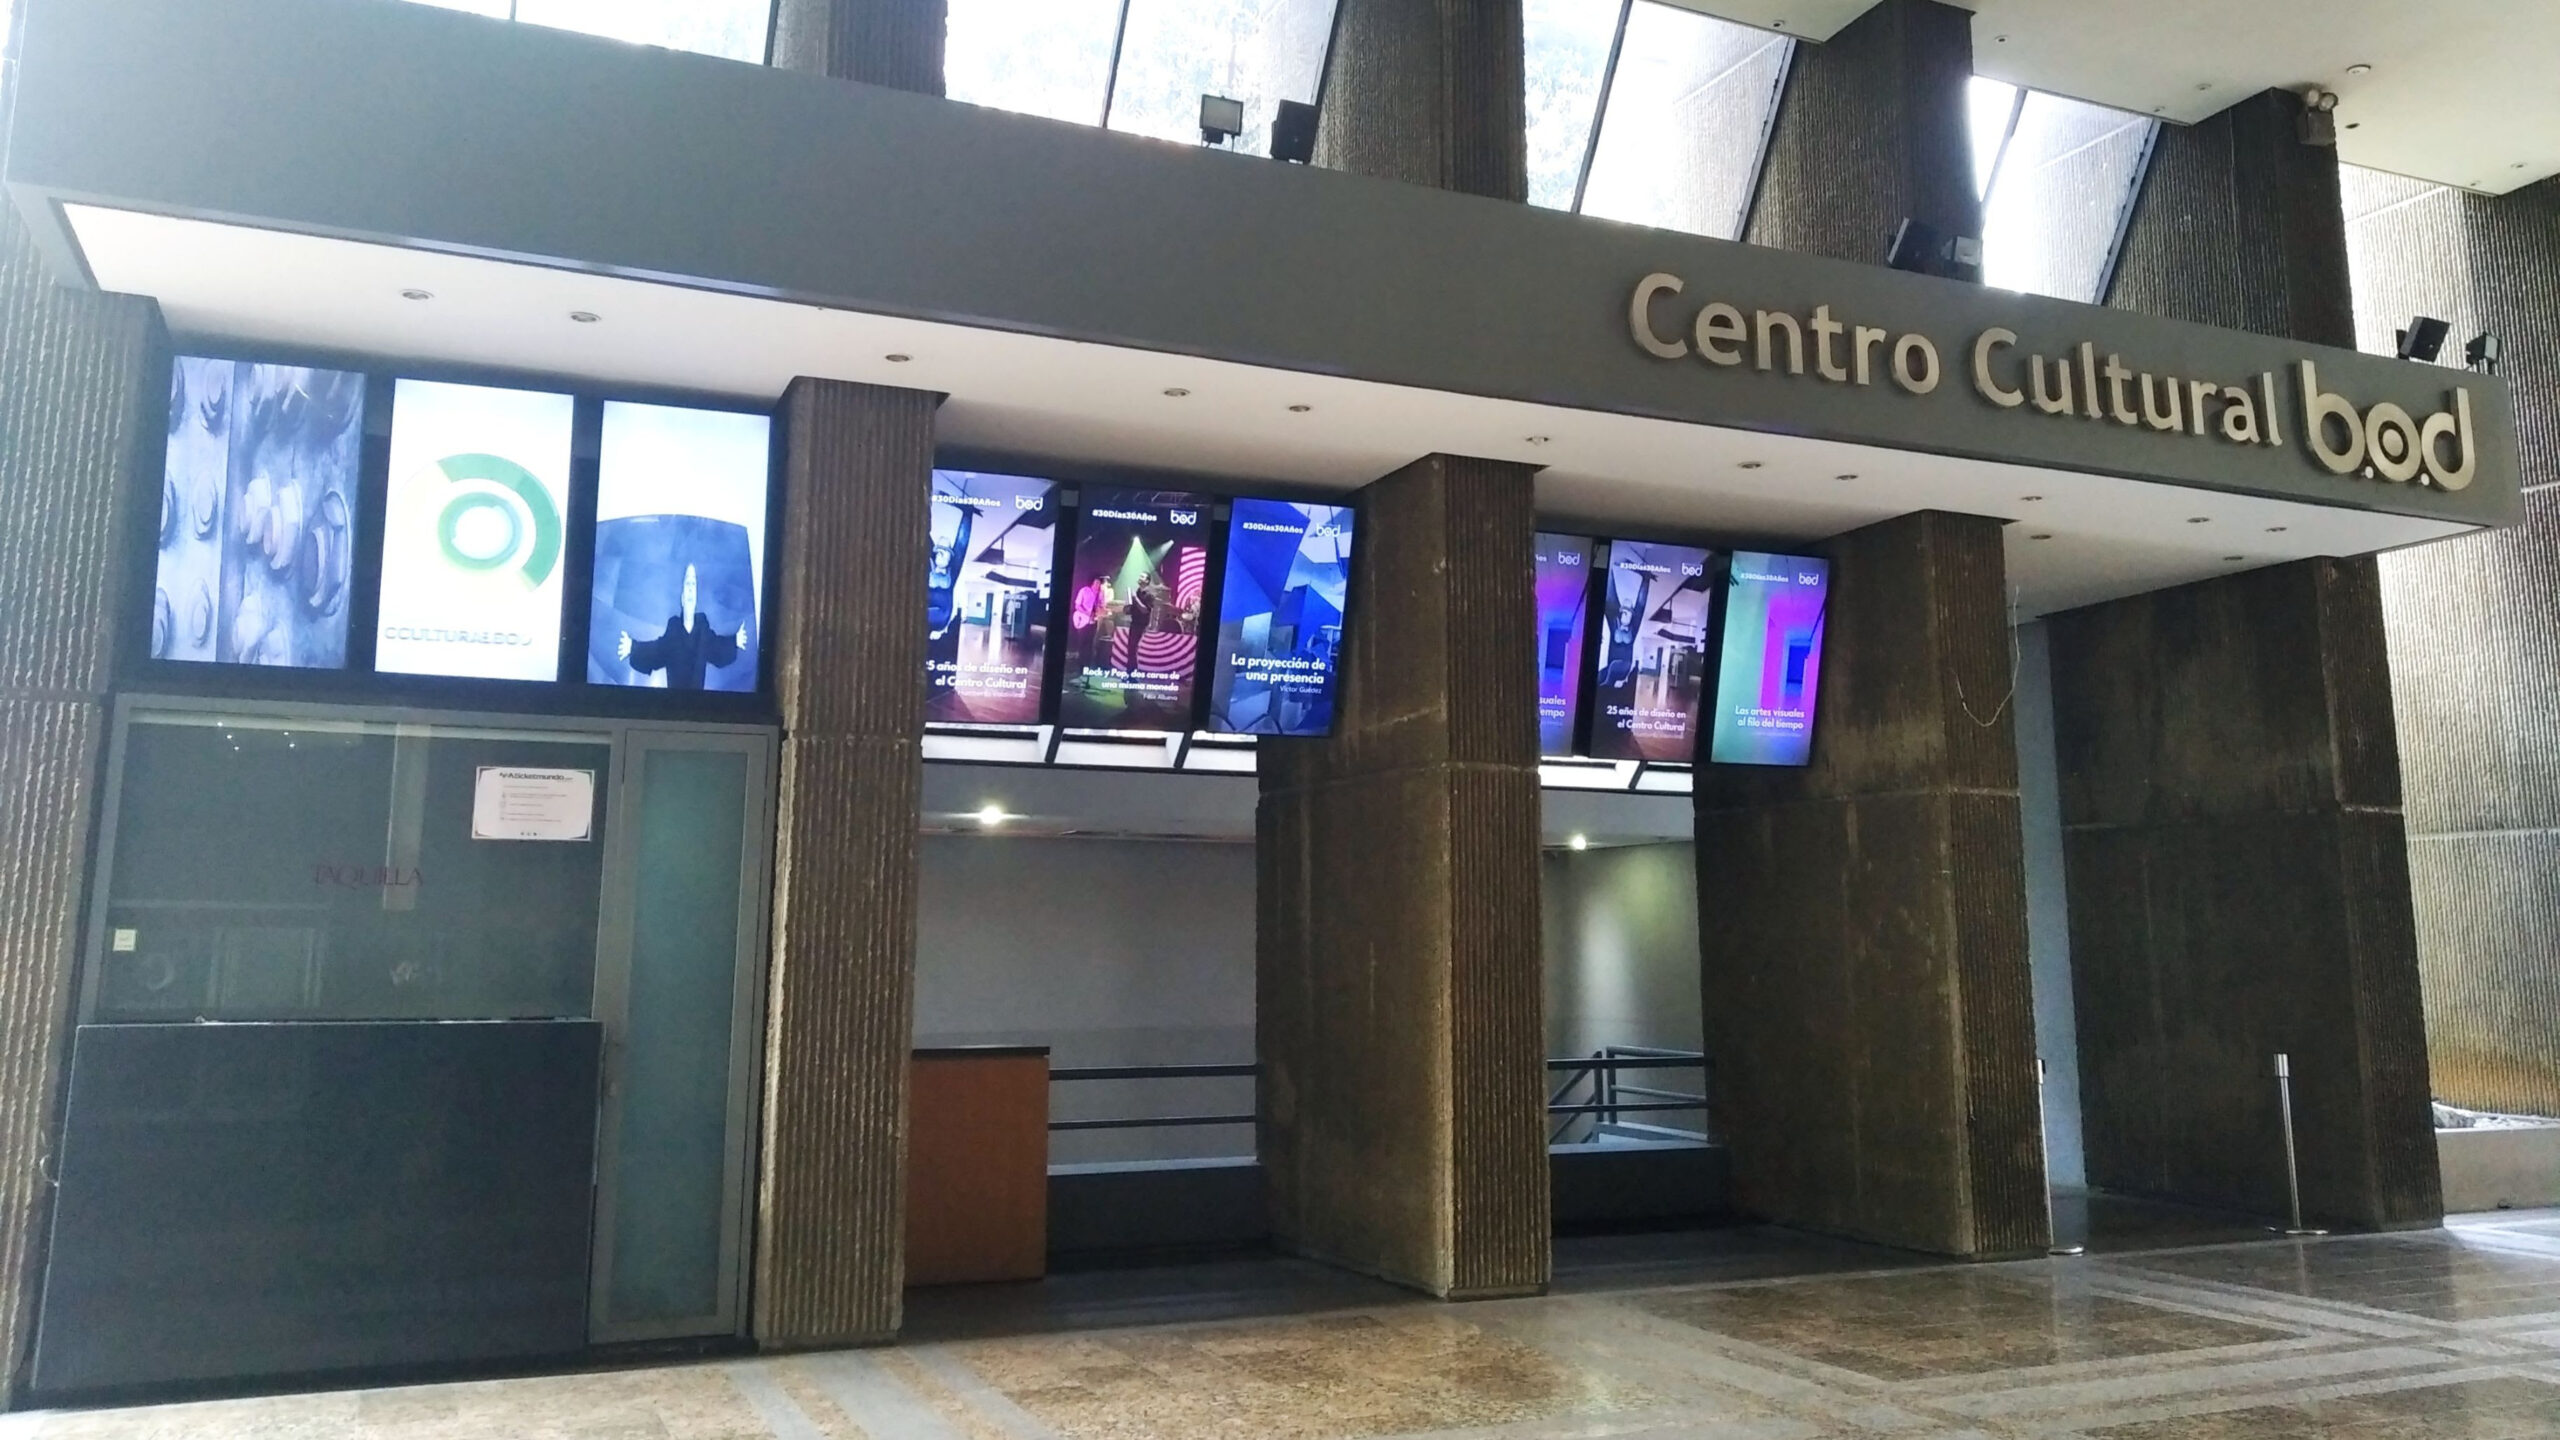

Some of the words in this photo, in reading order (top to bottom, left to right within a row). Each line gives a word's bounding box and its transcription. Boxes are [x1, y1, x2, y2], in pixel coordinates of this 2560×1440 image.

[1629, 272, 1940, 394] Centro
[1970, 327, 2283, 447] Cultural
[925, 660, 936, 671] 5
[936, 661, 962, 672] años
[964, 662, 977, 673] de
[979, 662, 1014, 674] diseño
[1231, 653, 1246, 666] La
[1247, 657, 1309, 670] proyección
[1311, 658, 1326, 670] de
[1082, 667, 1104, 676] Rock
[1104, 670, 1110, 678] y
[1131, 669, 1146, 679] dos
[1146, 671, 1169, 679] caras
[1169, 671, 1180, 680] de
[1245, 672, 1268, 681] una
[1270, 672, 1325, 685] presencia
[935, 675, 946, 686] el
[947, 676, 983, 688] Centro
[985, 677, 1027, 689] Cultural
[1119, 681, 1145, 690] misma
[1146, 683, 1179, 691] moneda
[1539, 694, 1566, 706] suales
[1539, 708, 1566, 719] empo
[1606, 705, 1618, 715] 25
[1618, 706, 1637, 716] años
[1638, 706, 1649, 716] de
[1650, 706, 1675, 718] diseño
[1677, 711, 1687, 719] en
[1735, 705, 1749, 715] Las
[1750, 707, 1772, 717] artes
[1773, 707, 1805, 718] visuales
[1617, 719, 1626, 728] el
[1626, 720, 1652, 730] Centro
[1654, 722, 1686, 731] Cultural
[1737, 716, 1746, 726] al
[1747, 717, 1760, 727] filo
[1761, 718, 1775, 728] del
[1775, 719, 1804, 731] tiempo
